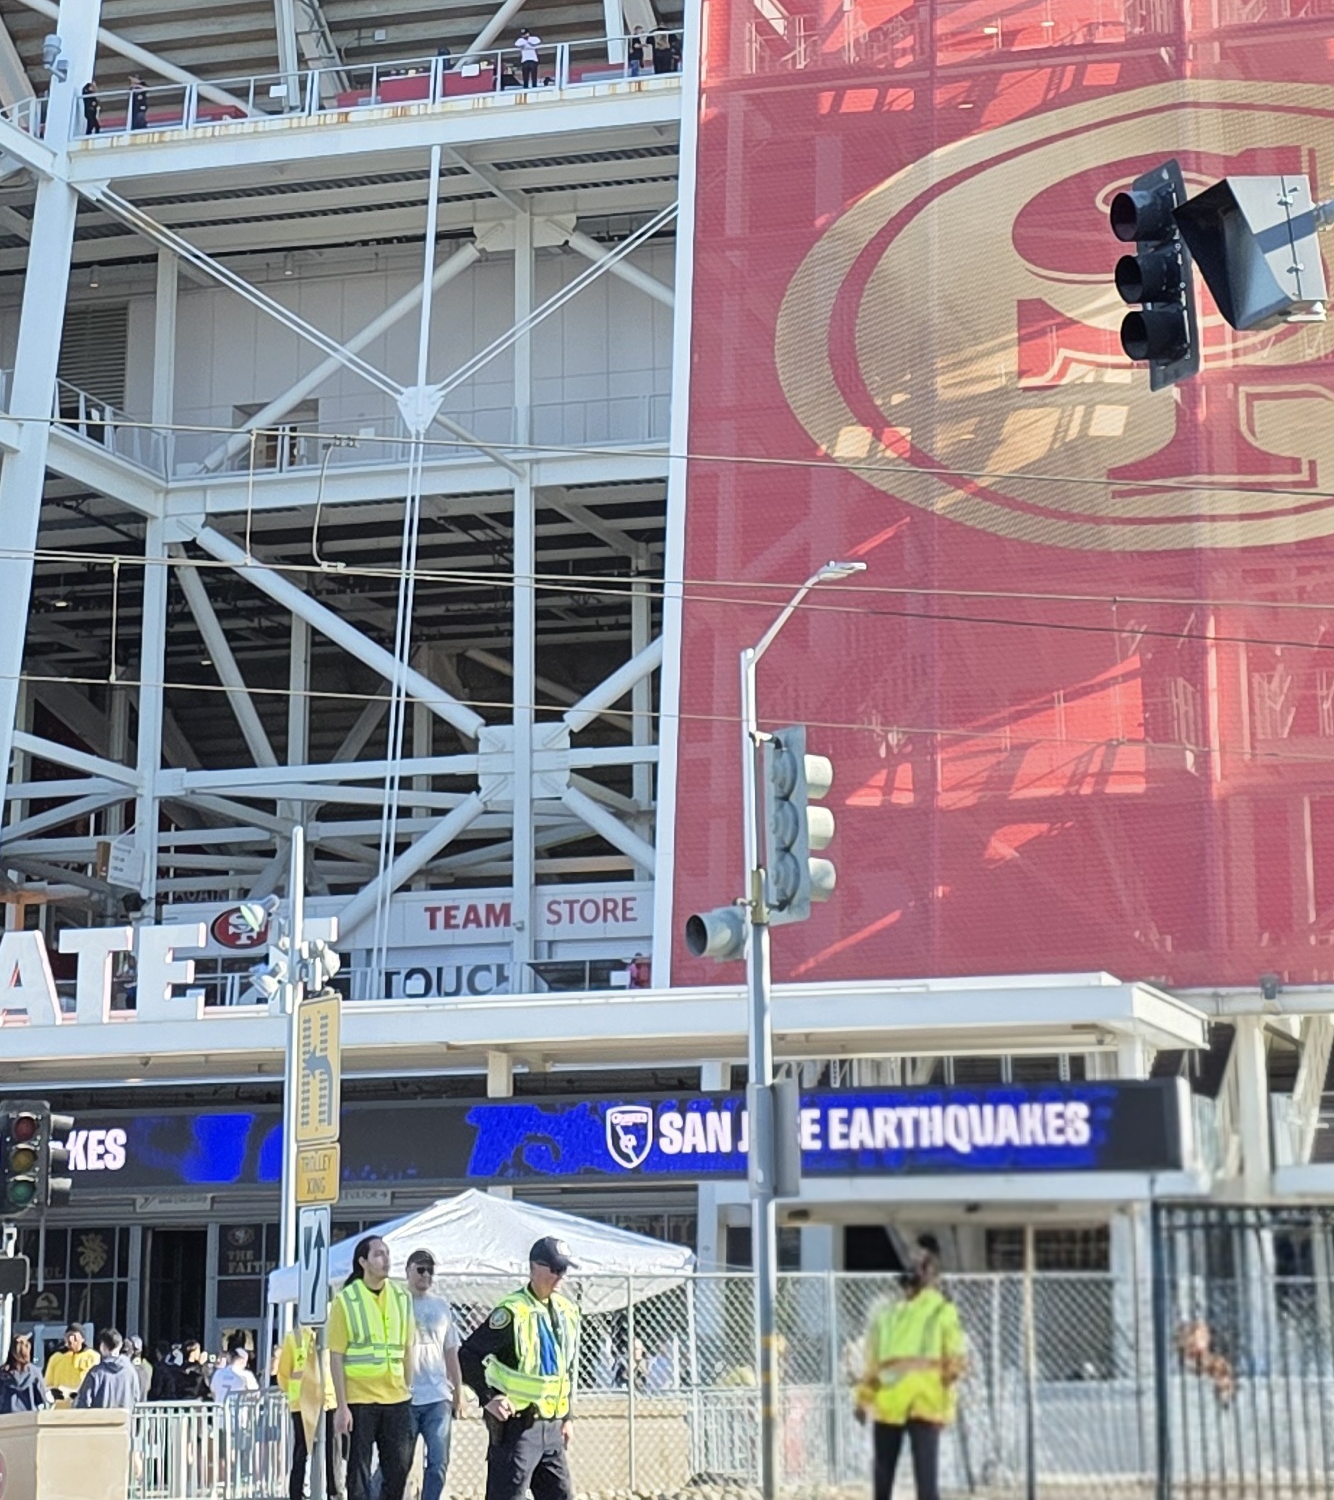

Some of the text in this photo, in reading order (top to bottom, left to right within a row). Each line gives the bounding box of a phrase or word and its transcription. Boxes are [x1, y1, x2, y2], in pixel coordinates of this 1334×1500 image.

[424, 897, 638, 931] TEAM STORE
[659, 1111, 732, 1154] SAN
[829, 1103, 1091, 1153] EARTHQUAKES
[301, 1154, 331, 1172] TROLLEY
